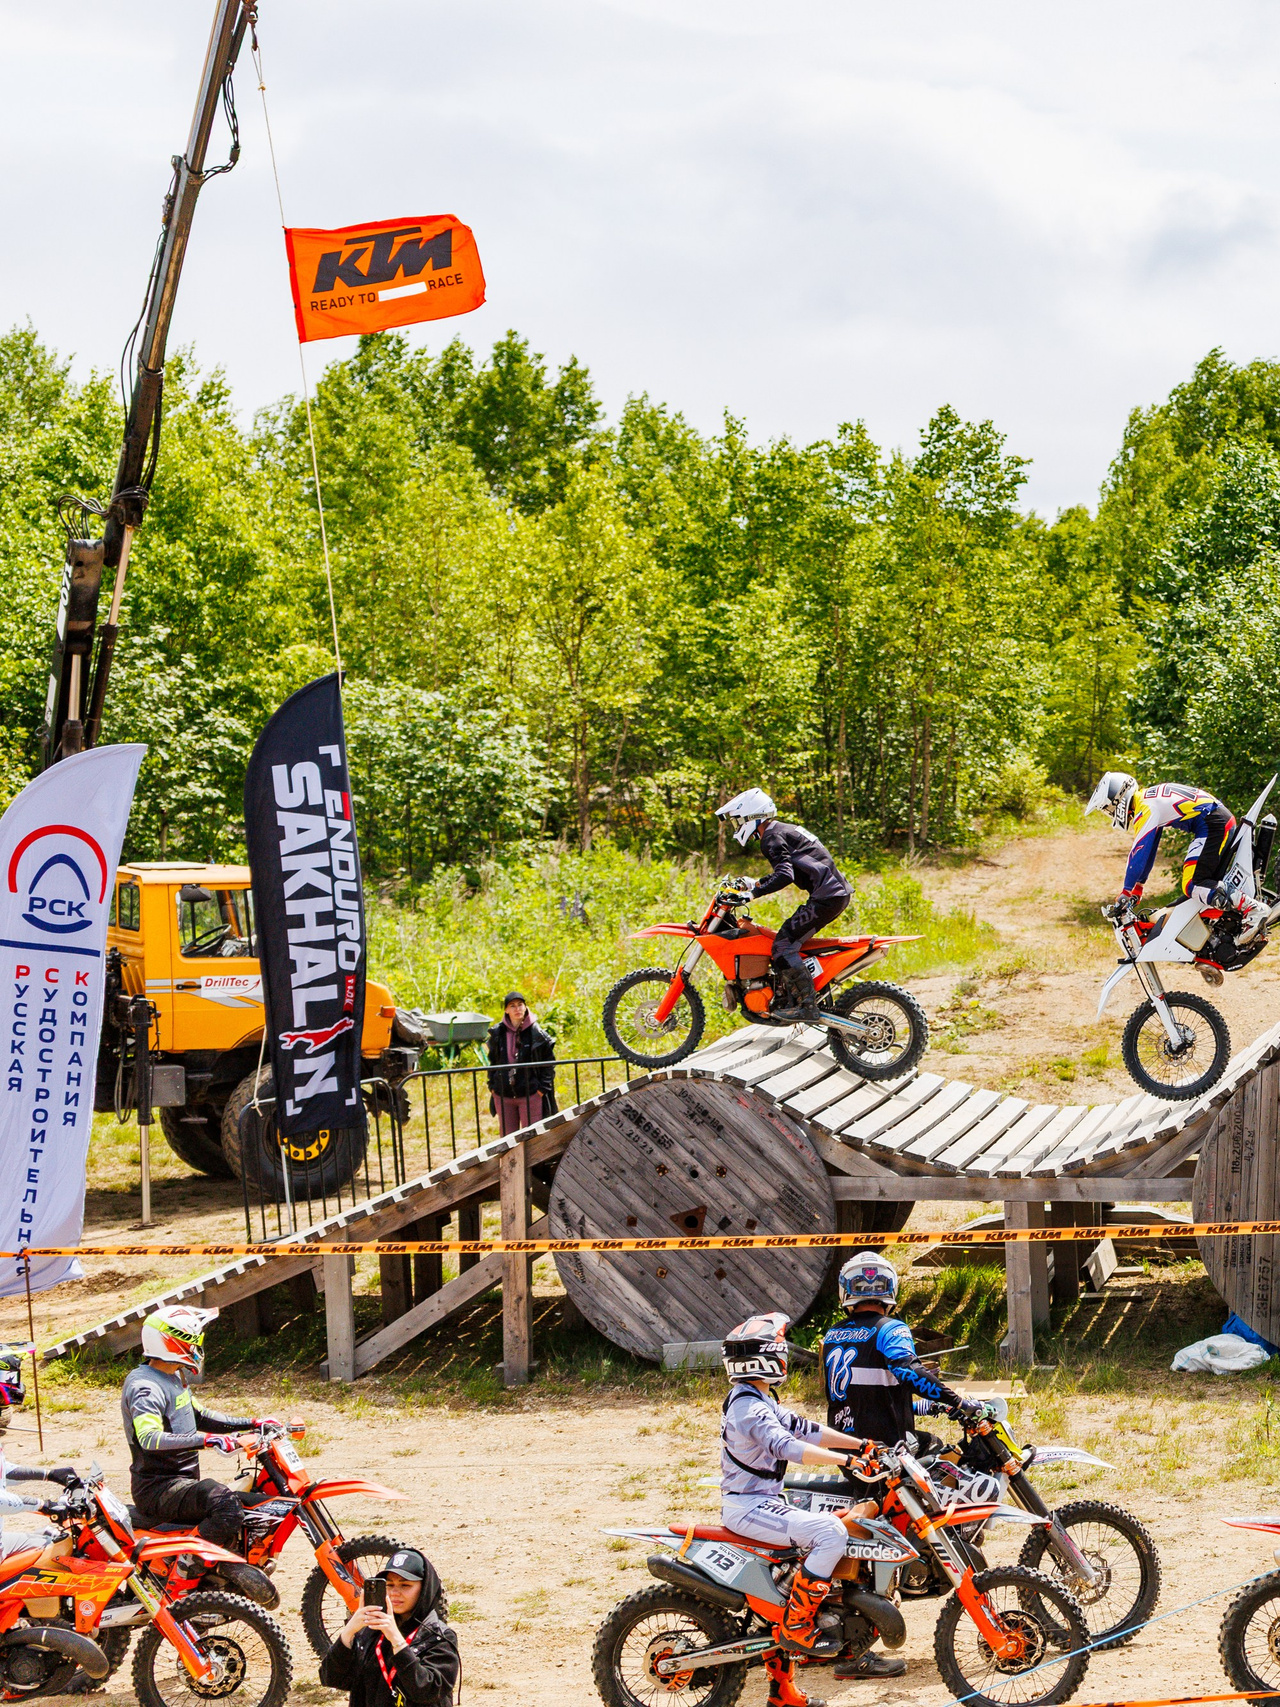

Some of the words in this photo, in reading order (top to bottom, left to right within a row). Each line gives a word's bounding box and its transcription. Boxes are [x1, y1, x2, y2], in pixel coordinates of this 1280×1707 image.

[312, 227, 452, 293] KTM
[310, 295, 355, 311] READY
[360, 292, 376, 304] TO
[428, 273, 464, 290] RACE
[324, 788, 363, 972] ENDURO
[28, 896, 86, 919] РСК
[791, 904, 818, 930] FOX
[204, 977, 249, 987] DrillTec
[8, 964, 31, 1092] РУССКАЯ
[62, 970, 90, 1127] КОМПАНИЯ
[116, 1246, 149, 1256] KTM
[159, 1246, 191, 1256] KTM
[202, 1246, 234, 1256] KTM
[245, 1246, 276, 1255] KTM
[288, 1246, 320, 1254] KTM
[331, 1244, 363, 1254] KTM
[374, 1244, 406, 1253] KTM
[417, 1242, 449, 1252] KTM
[460, 1242, 493, 1252] KTM
[504, 1242, 536, 1251] KTM
[547, 1241, 580, 1250] KTM
[590, 1240, 623, 1250] KTM
[634, 1240, 666, 1249] KTM
[678, 1239, 710, 1248] KTM
[721, 1238, 754, 1248] KTM
[765, 1238, 797, 1246] KTM
[808, 1236, 841, 1246] KTM
[852, 1236, 885, 1244] KTM
[896, 1234, 930, 1243] KTM
[940, 1233, 974, 1242] KTM
[984, 1232, 1018, 1240] KTM
[1028, 1230, 1062, 1239] KTM
[1073, 1229, 1106, 1238] KTM
[1118, 1228, 1150, 1236] KTM
[1162, 1226, 1195, 1235] KTM
[1206, 1224, 1240, 1234] KTM
[165, 1324, 200, 1344] 100%
[825, 1497, 850, 1505] SILVER
[705, 1549, 735, 1571] 113
[718, 1545, 740, 1561] SILVER
